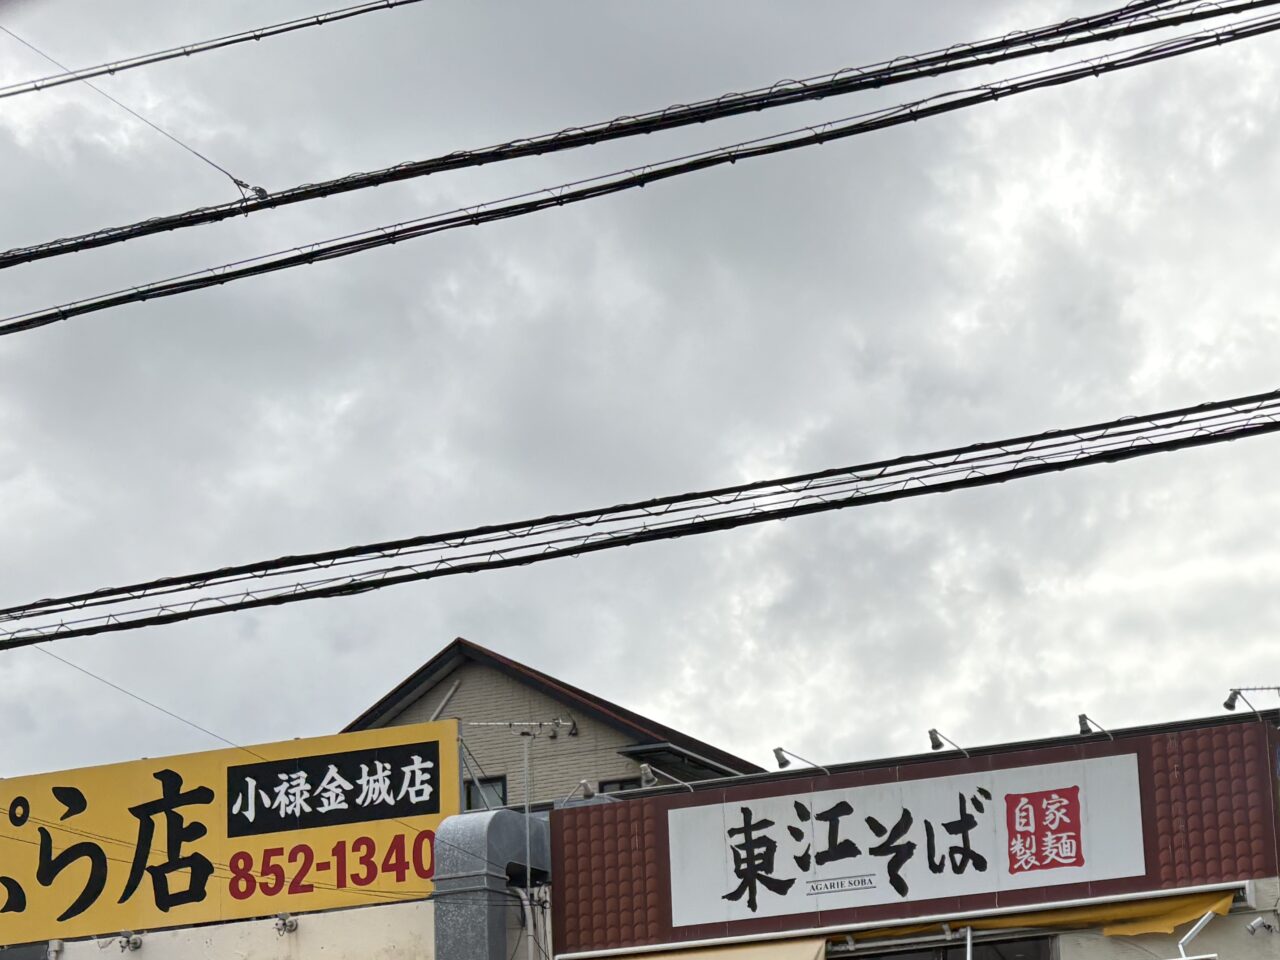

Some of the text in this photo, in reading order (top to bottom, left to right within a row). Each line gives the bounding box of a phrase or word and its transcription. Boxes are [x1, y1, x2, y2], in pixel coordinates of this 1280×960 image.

[231, 755, 435, 824] 小禄金城店
[228, 830, 435, 900] 852-1340
[722, 787, 992, 912] 東江そば
[810, 878, 873, 892] AGARIE SOBA
